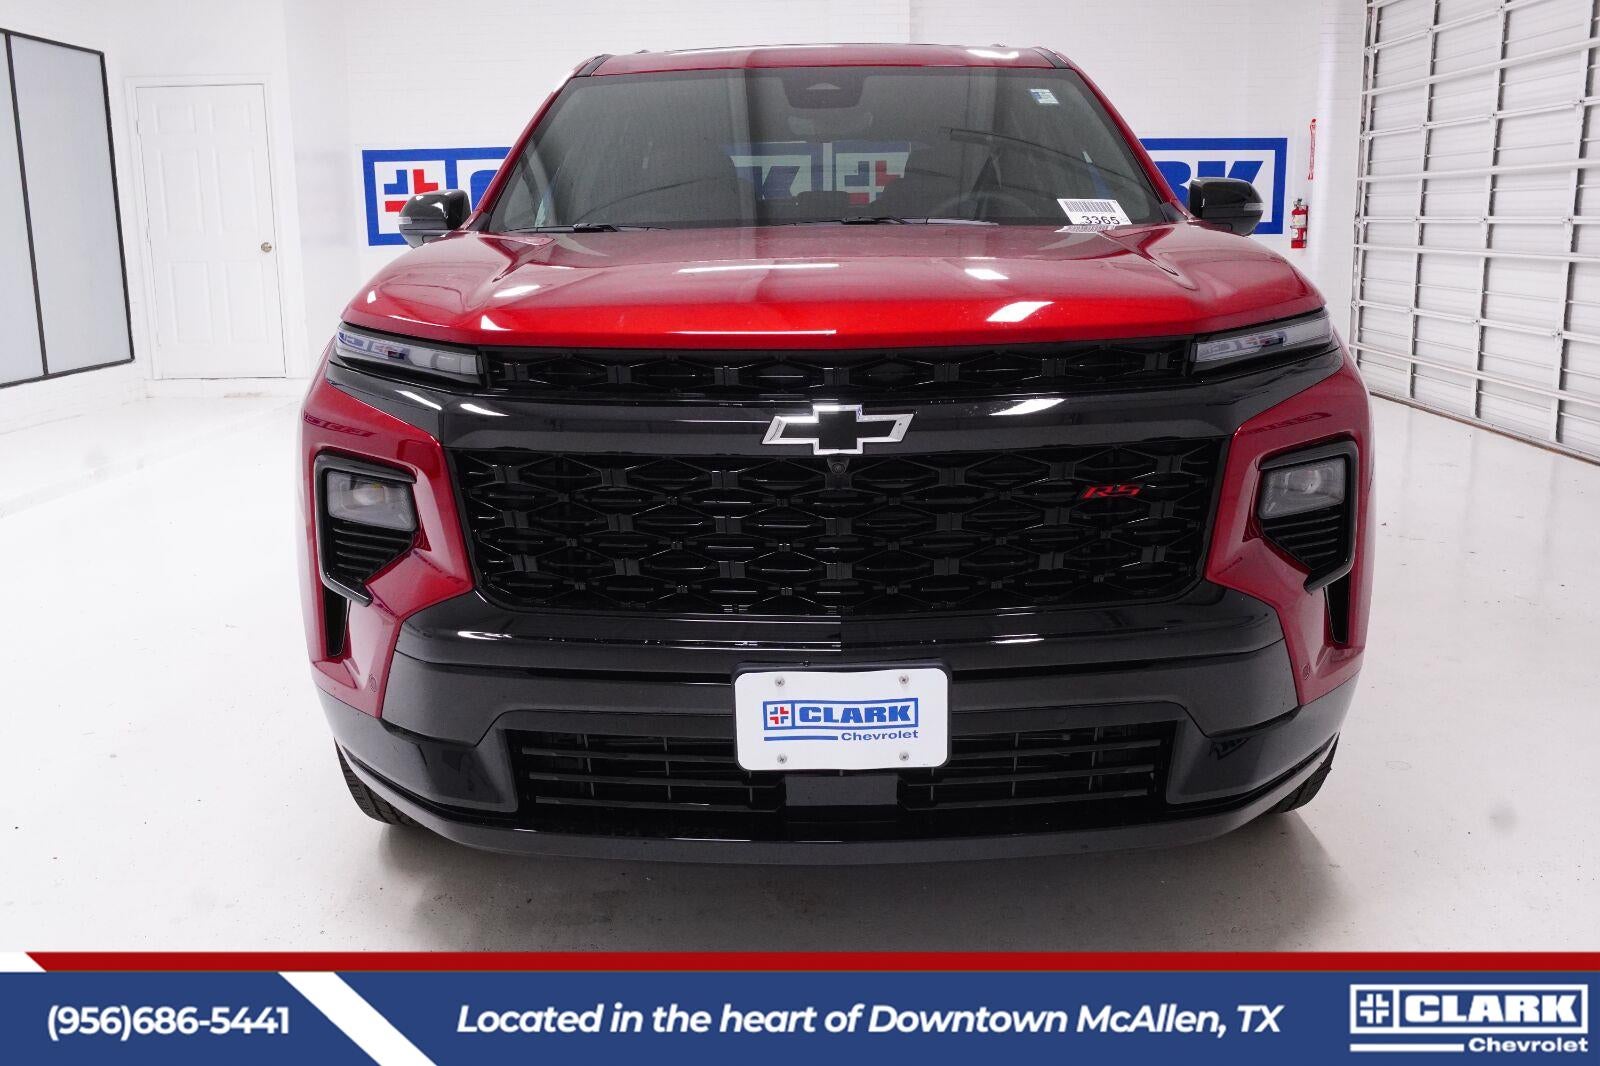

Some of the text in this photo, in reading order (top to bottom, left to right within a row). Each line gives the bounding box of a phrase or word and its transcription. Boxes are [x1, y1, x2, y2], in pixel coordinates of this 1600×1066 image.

[1081, 215, 1120, 225] 3365
[1082, 484, 1141, 499] RS
[799, 705, 911, 723] CLARK
[841, 730, 919, 741] Chevrolet
